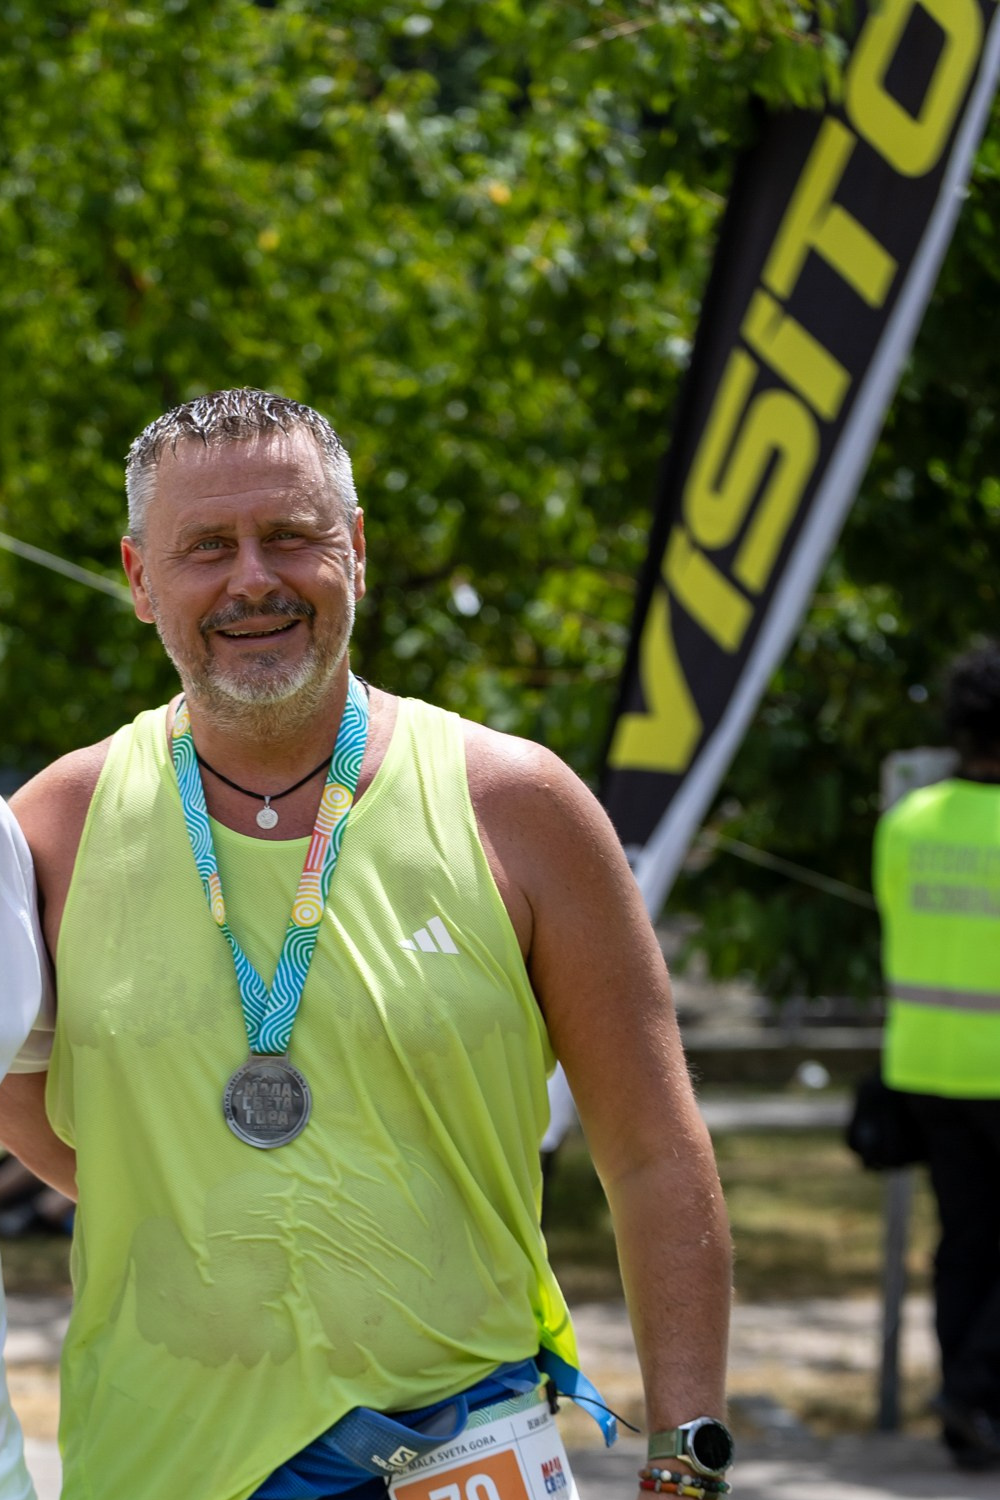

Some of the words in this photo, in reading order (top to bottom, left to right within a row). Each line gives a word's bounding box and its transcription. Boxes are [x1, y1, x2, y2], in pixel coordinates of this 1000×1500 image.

[608, 0, 984, 772] VISITO
[437, 1445, 469, 1462] SVETA
[468, 1434, 497, 1450] GORA
